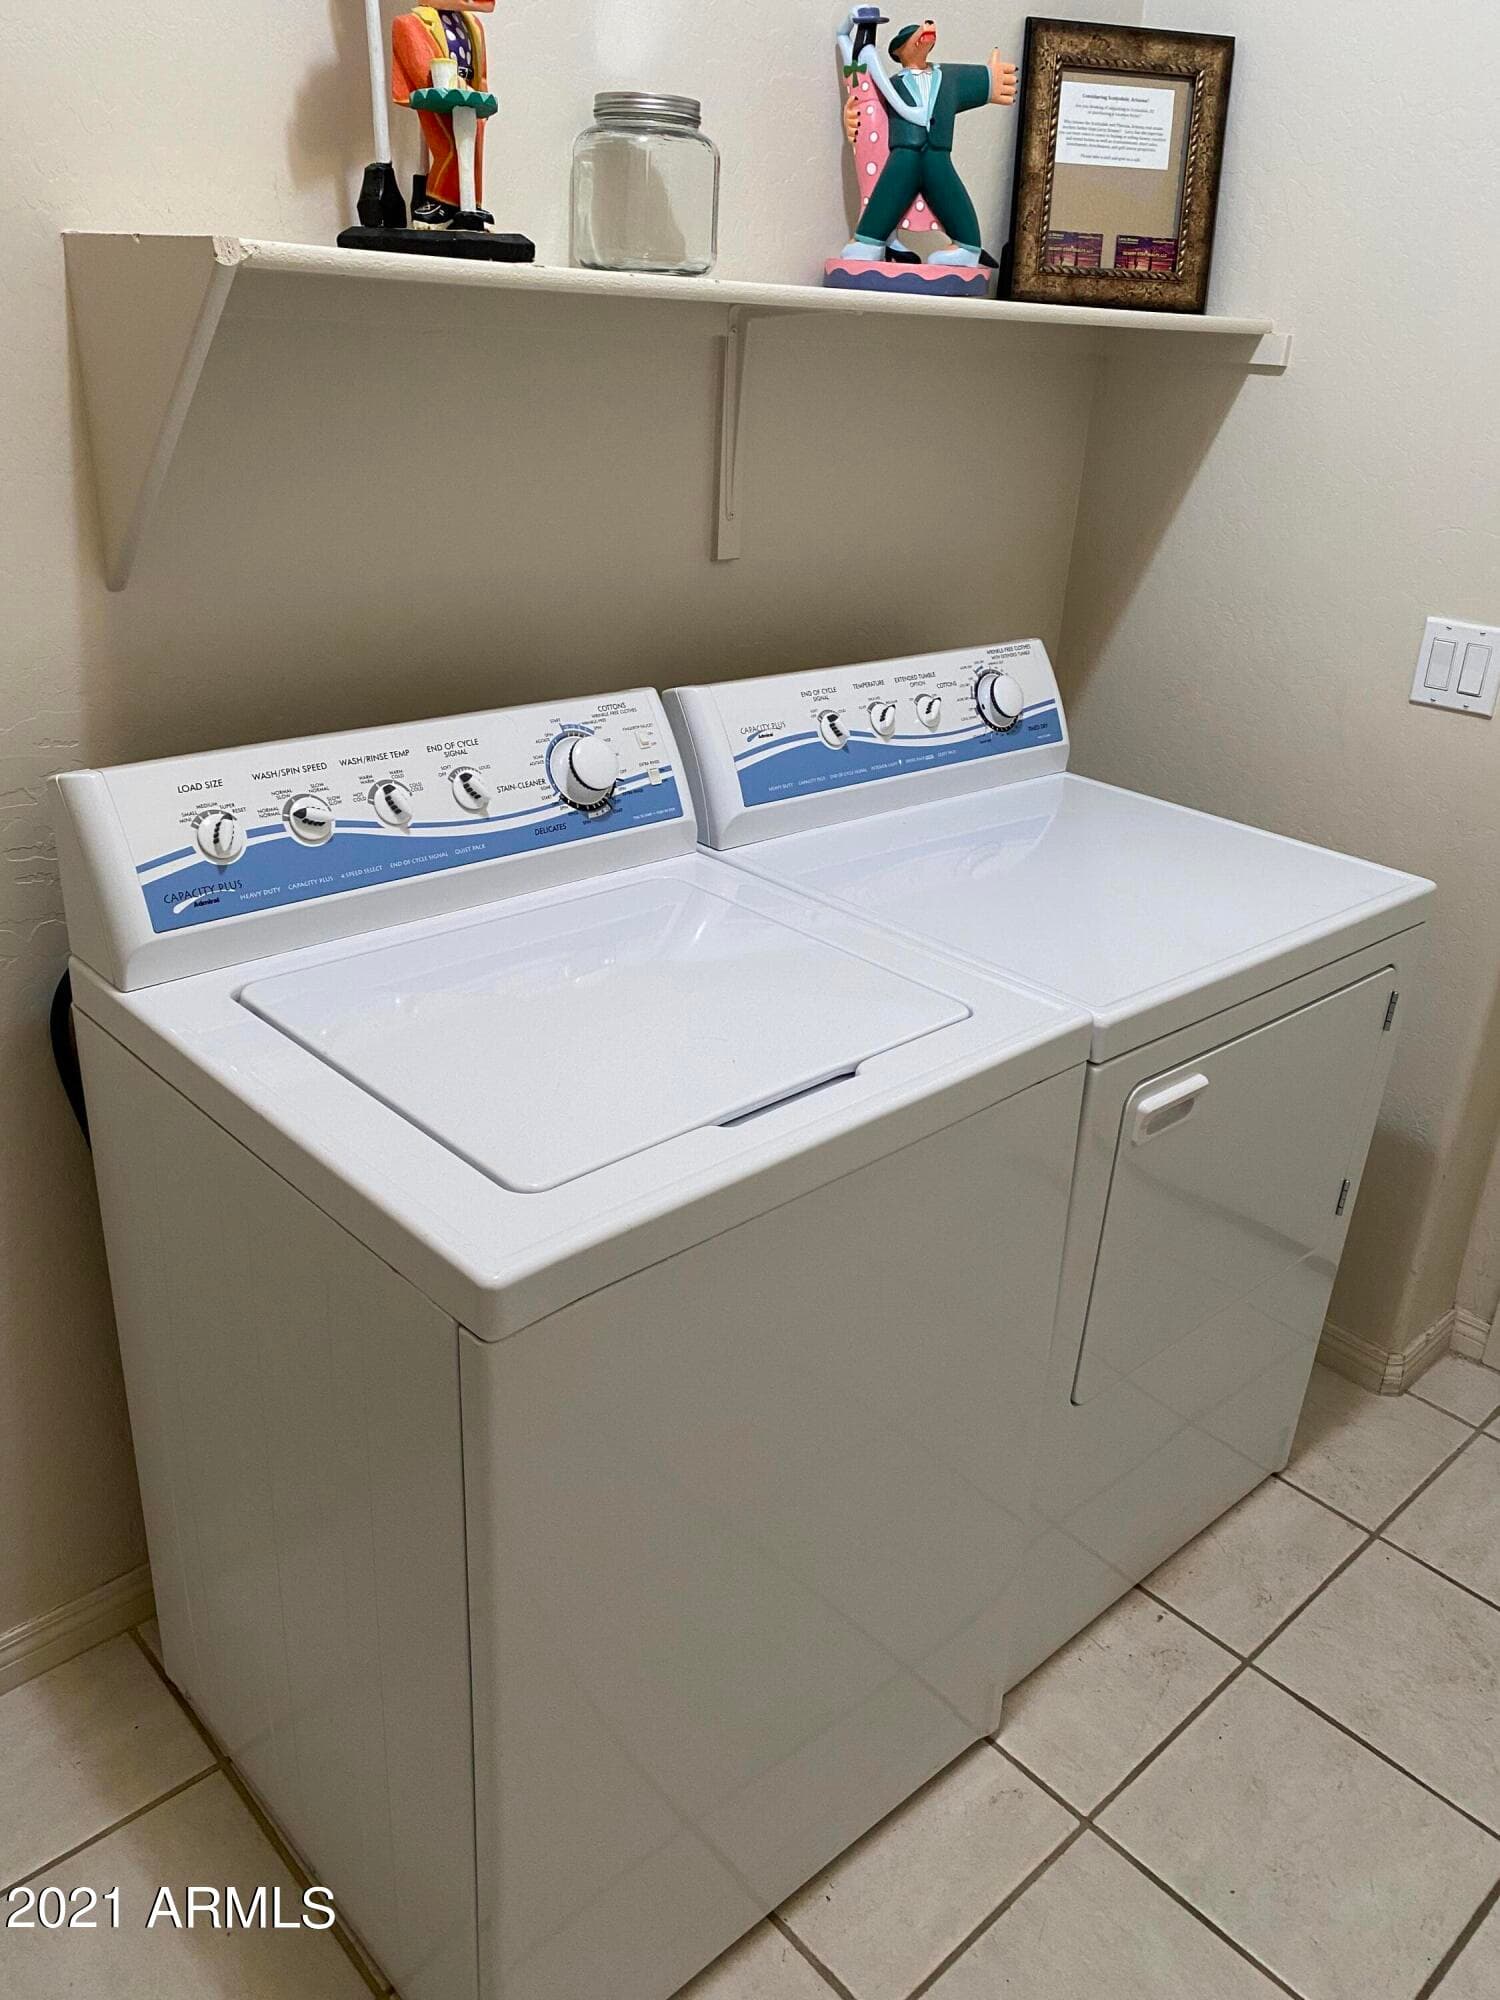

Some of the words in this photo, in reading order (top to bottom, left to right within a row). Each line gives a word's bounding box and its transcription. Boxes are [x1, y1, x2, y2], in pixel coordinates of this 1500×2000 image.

[852, 679, 884, 690] TEMPERATURE
[800, 690, 812, 698] END
[822, 686, 838, 694] CYCLE
[598, 702, 626, 712] COTTONS
[740, 722, 769, 735] CAPACITY
[772, 722, 786, 730] PLUS
[426, 744, 443, 753] END
[444, 742, 455, 750] OF
[456, 738, 479, 748] CYCLE
[338, 752, 388, 766] WASH/RINSE
[389, 749, 410, 759] TEMP
[444, 748, 468, 758] SIGNAL
[252, 766, 300, 780] WASH/SPIN
[302, 762, 328, 773] SPEED
[178, 782, 202, 794] LOAD
[204, 778, 223, 789] SIZE
[496, 778, 546, 794] STAIN-CLEANER
[220, 802, 235, 810] SUPER
[534, 823, 567, 836] DELICATES
[390, 860, 402, 868] END
[412, 856, 428, 864] CYCLE
[345, 870, 363, 878] SPEED
[364, 865, 384, 874] SELECT
[288, 879, 318, 890] CAPACITY
[319, 875, 334, 884] PLUS
[164, 884, 216, 904] CAPACITY
[218, 880, 243, 893] PLUS
[240, 891, 262, 900] HEAVY
[263, 886, 281, 896] DUTY
[194, 896, 220, 908] Admiral
